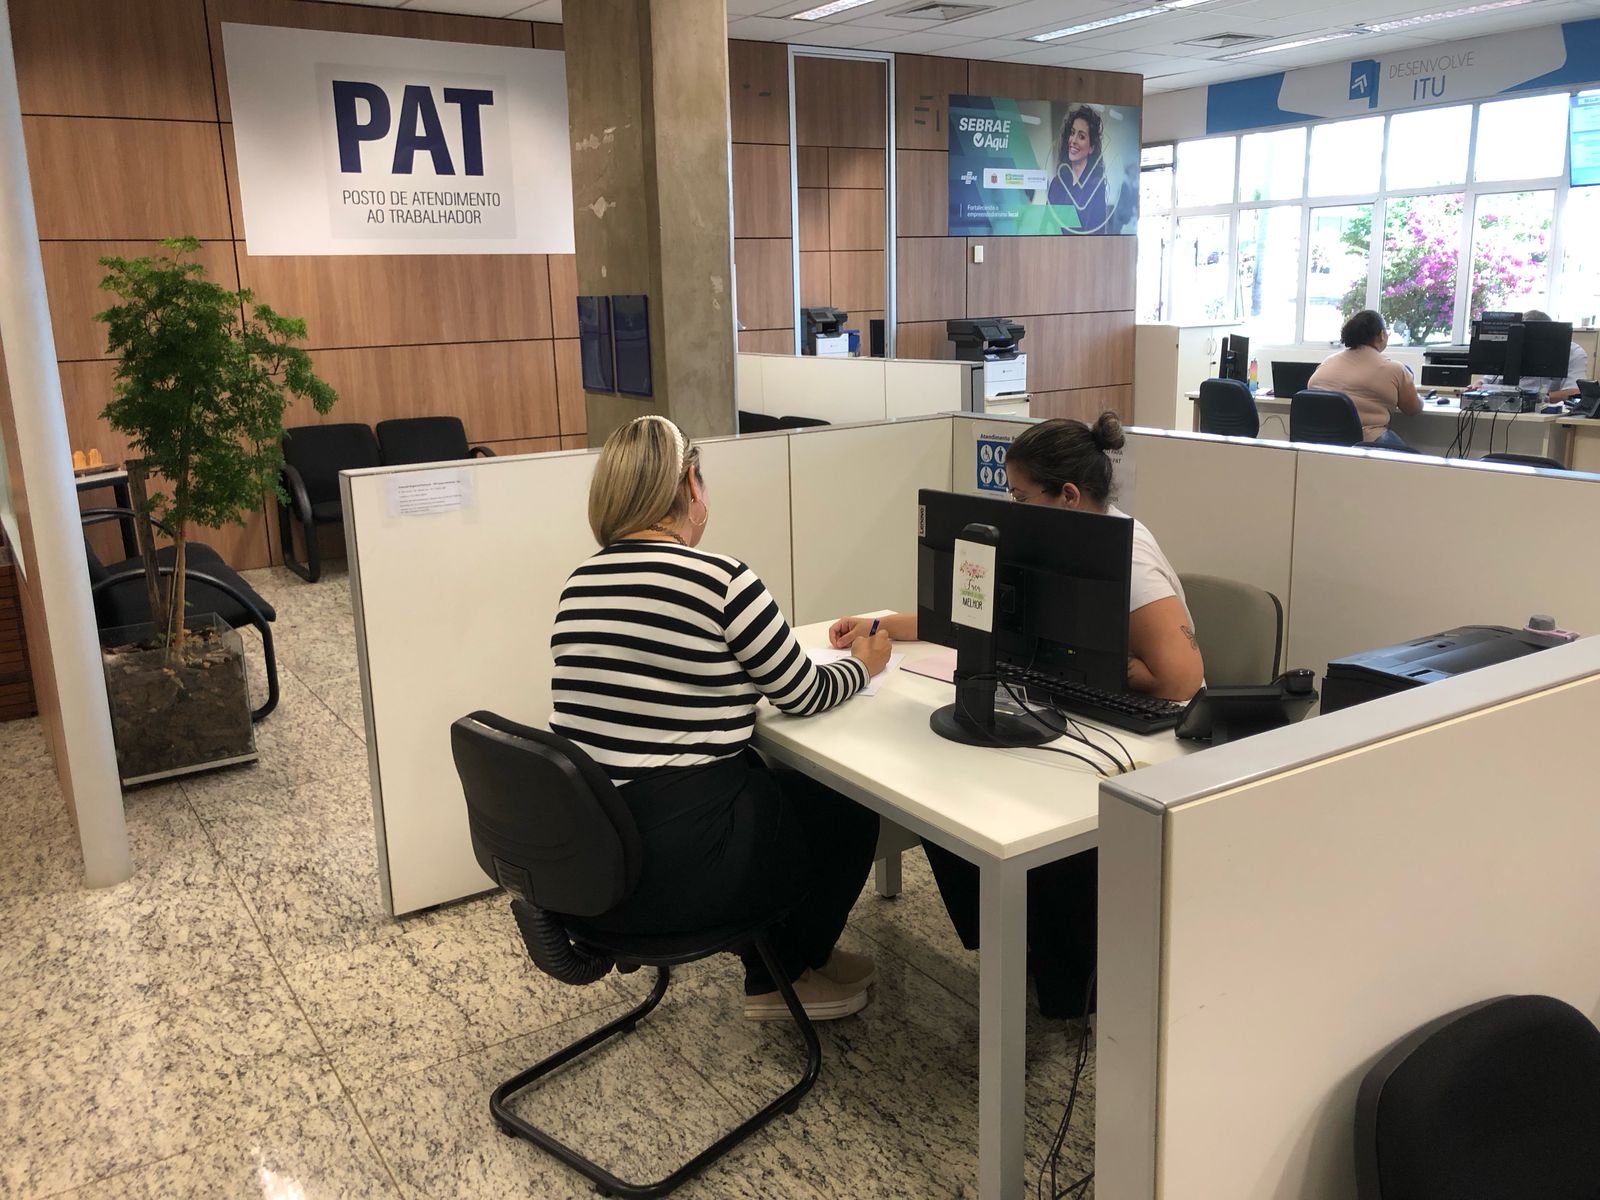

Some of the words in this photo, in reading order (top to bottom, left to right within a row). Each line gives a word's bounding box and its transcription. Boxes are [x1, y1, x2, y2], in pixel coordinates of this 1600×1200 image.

[1389, 51, 1476, 79] DESENVOLVE
[1413, 75, 1446, 101] ITU
[331, 79, 494, 177] PAT
[959, 117, 1011, 133] SEBRAE
[984, 134, 1009, 151] Aqui
[342, 190, 386, 206] POSTO
[390, 191, 408, 206] DE
[412, 191, 501, 207] ATENDIMENTO
[367, 208, 385, 224] AO
[390, 208, 482, 225] TRABALHADOR
[962, 596, 983, 611] MELHOR
